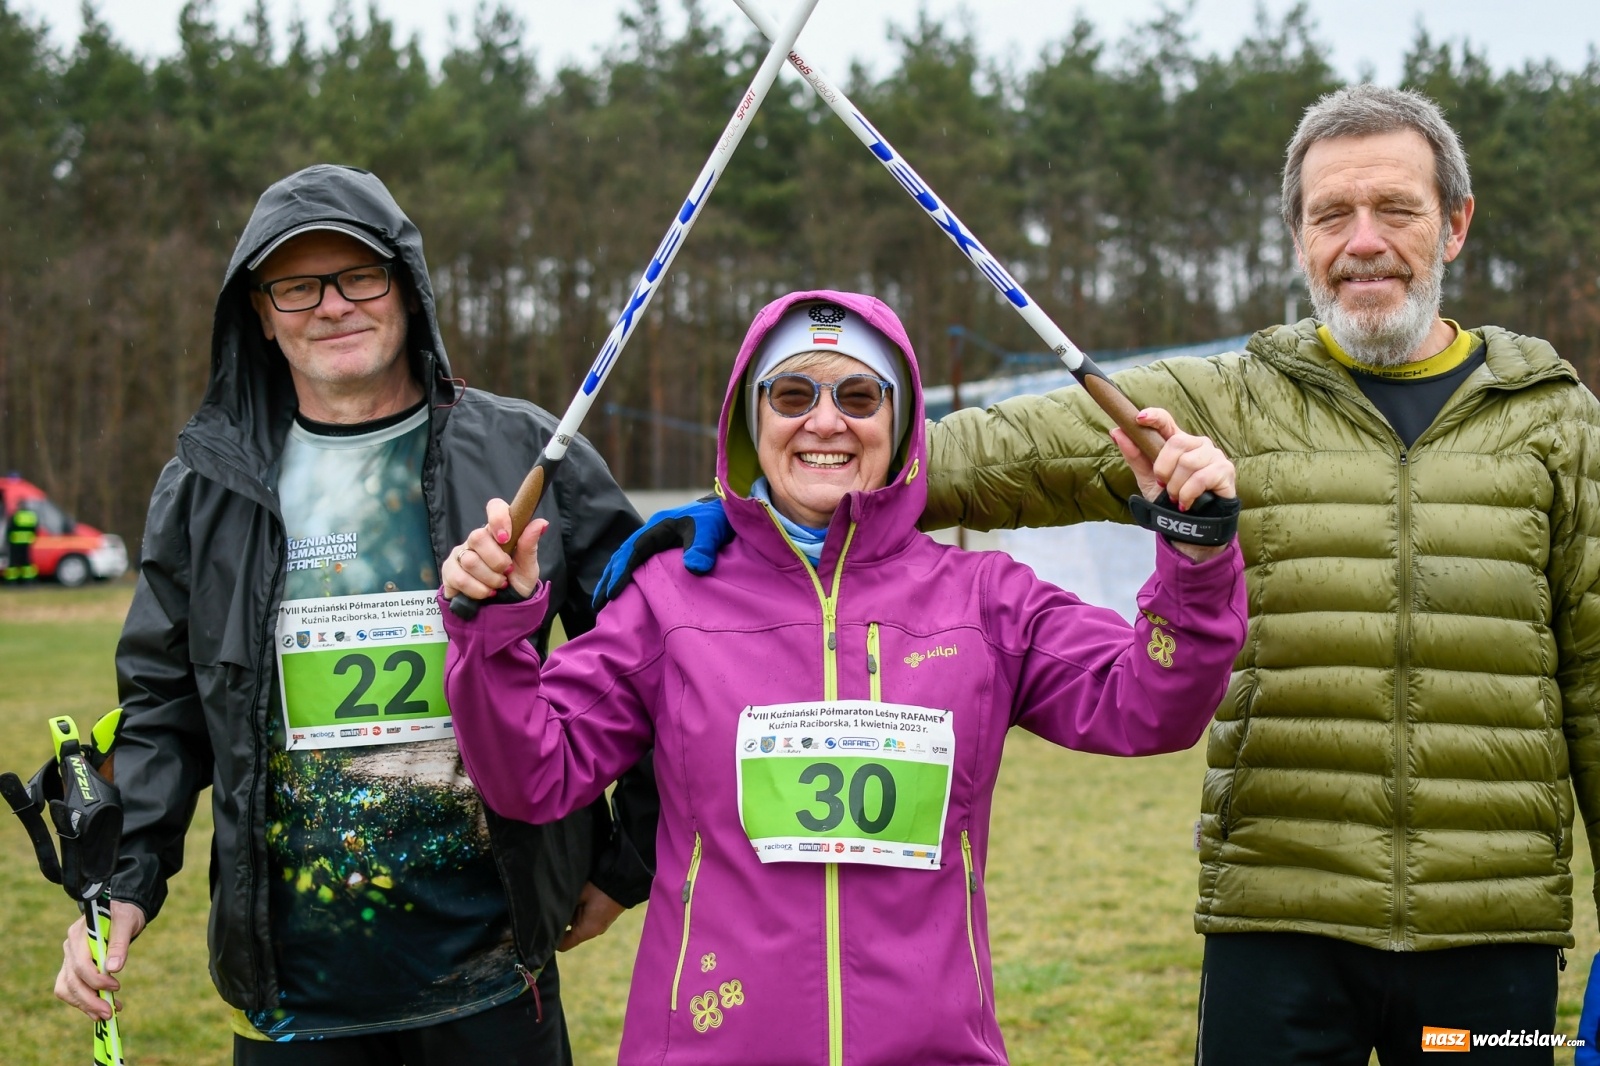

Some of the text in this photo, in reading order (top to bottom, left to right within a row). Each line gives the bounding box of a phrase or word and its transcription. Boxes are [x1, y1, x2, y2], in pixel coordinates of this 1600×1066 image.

[736, 89, 756, 121] SPORT
[851, 111, 1029, 309] EXEL
[582, 169, 716, 396] EXEL
[1156, 515, 1204, 538] EXEL
[285, 607, 300, 615] VIII
[301, 603, 348, 614] Kuźniański
[349, 600, 399, 610] Półmaraton
[401, 597, 425, 607] Leśny
[301, 616, 330, 625] Kuźnia
[331, 612, 380, 622] Raciborska,
[387, 608, 424, 618] kwietnia
[926, 644, 958, 659] kilpi
[333, 650, 429, 719] 22
[752, 712, 769, 720] VIII
[770, 708, 818, 720] Kuźniański
[820, 707, 873, 717] Półmaraton
[875, 709, 899, 720] Leśny
[768, 722, 798, 731] Kuźnia
[799, 719, 851, 729] Raciborska,
[861, 719, 898, 731] kwietnia
[899, 722, 921, 732] 2023
[70, 757, 94, 800] FIZAN
[795, 762, 897, 834] 30
